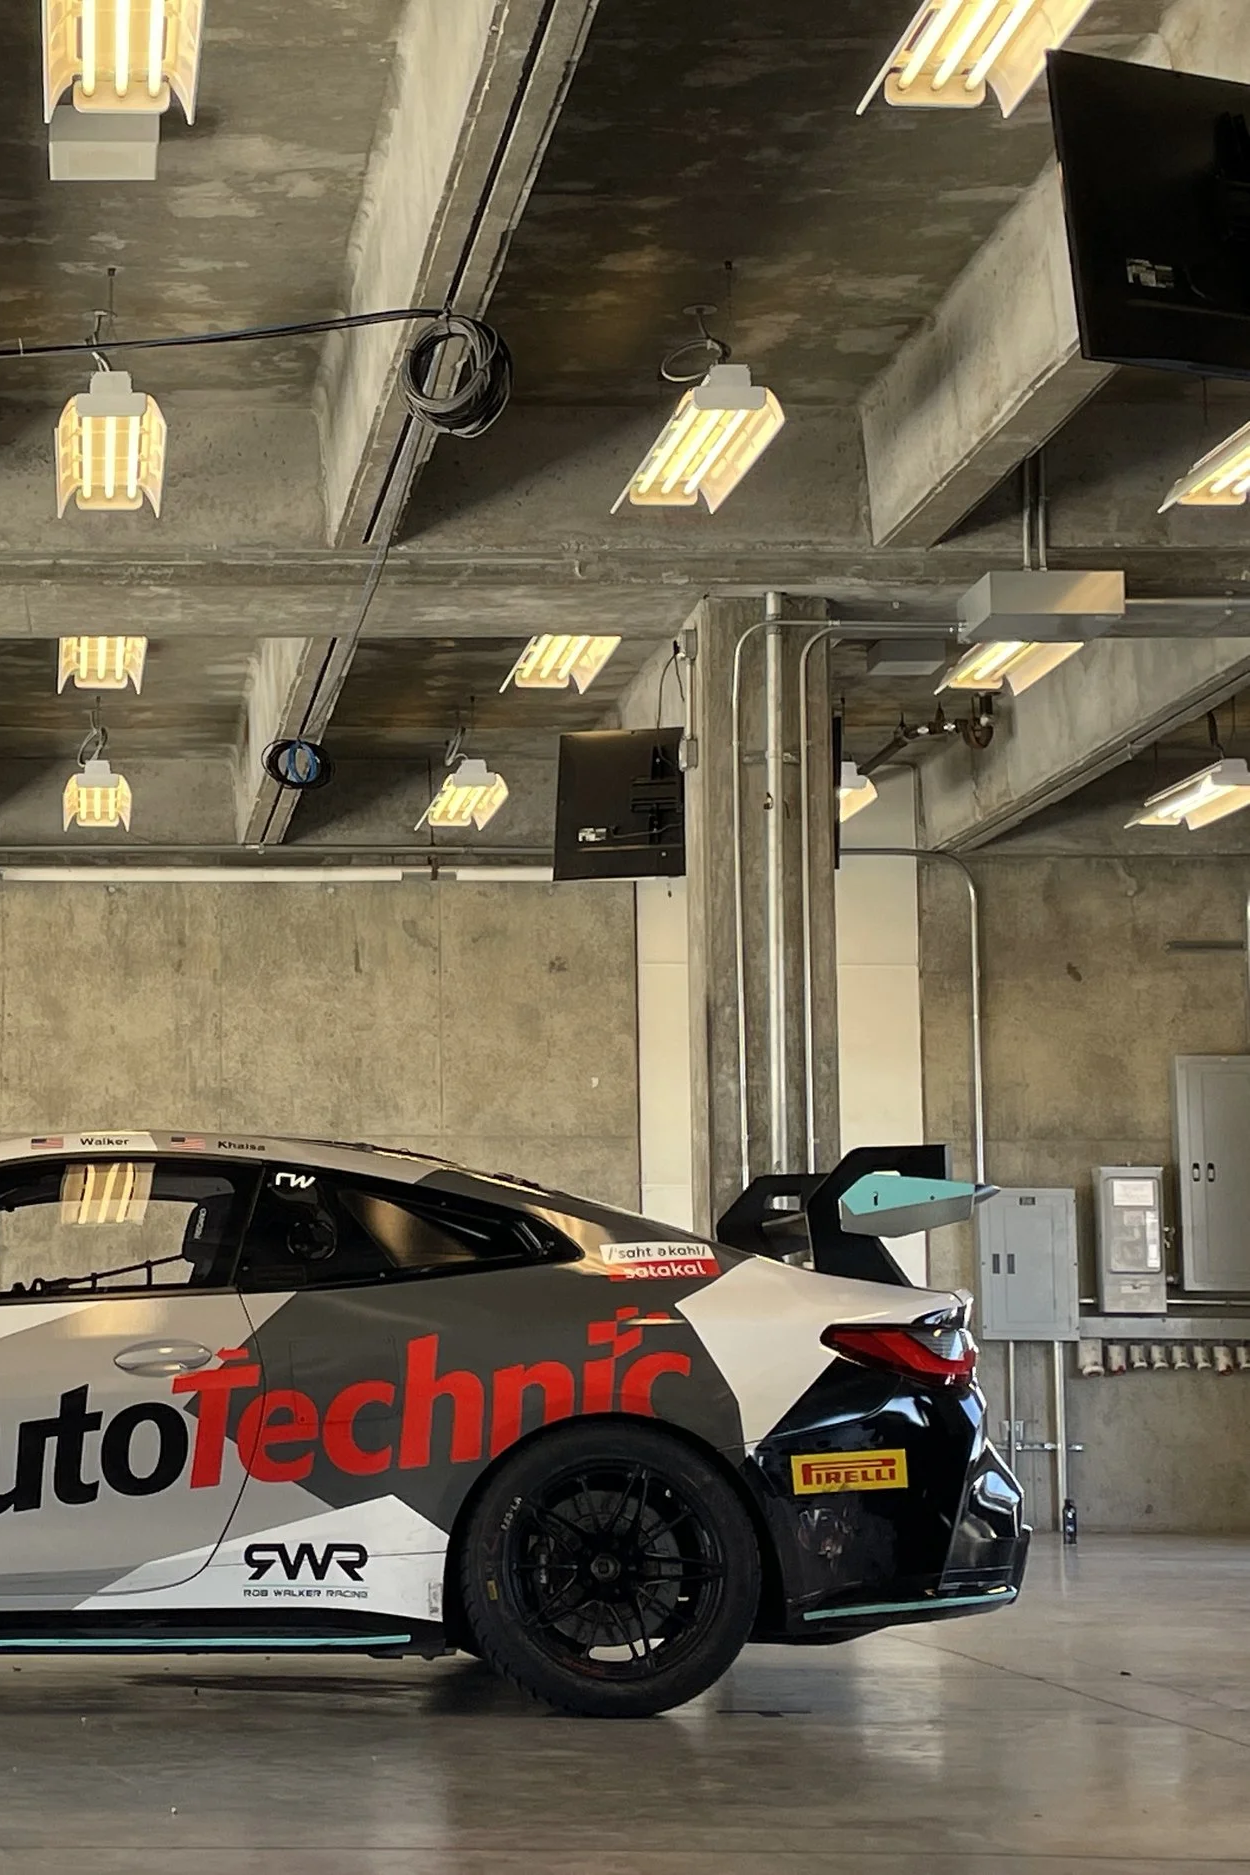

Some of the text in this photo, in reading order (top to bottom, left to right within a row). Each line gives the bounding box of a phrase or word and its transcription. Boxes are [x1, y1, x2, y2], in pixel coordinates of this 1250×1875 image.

[80, 1137, 129, 1146] Walker
[801, 1458, 896, 1486] PIRELLI
[243, 1589, 369, 1599] ROB WALKER RACING
